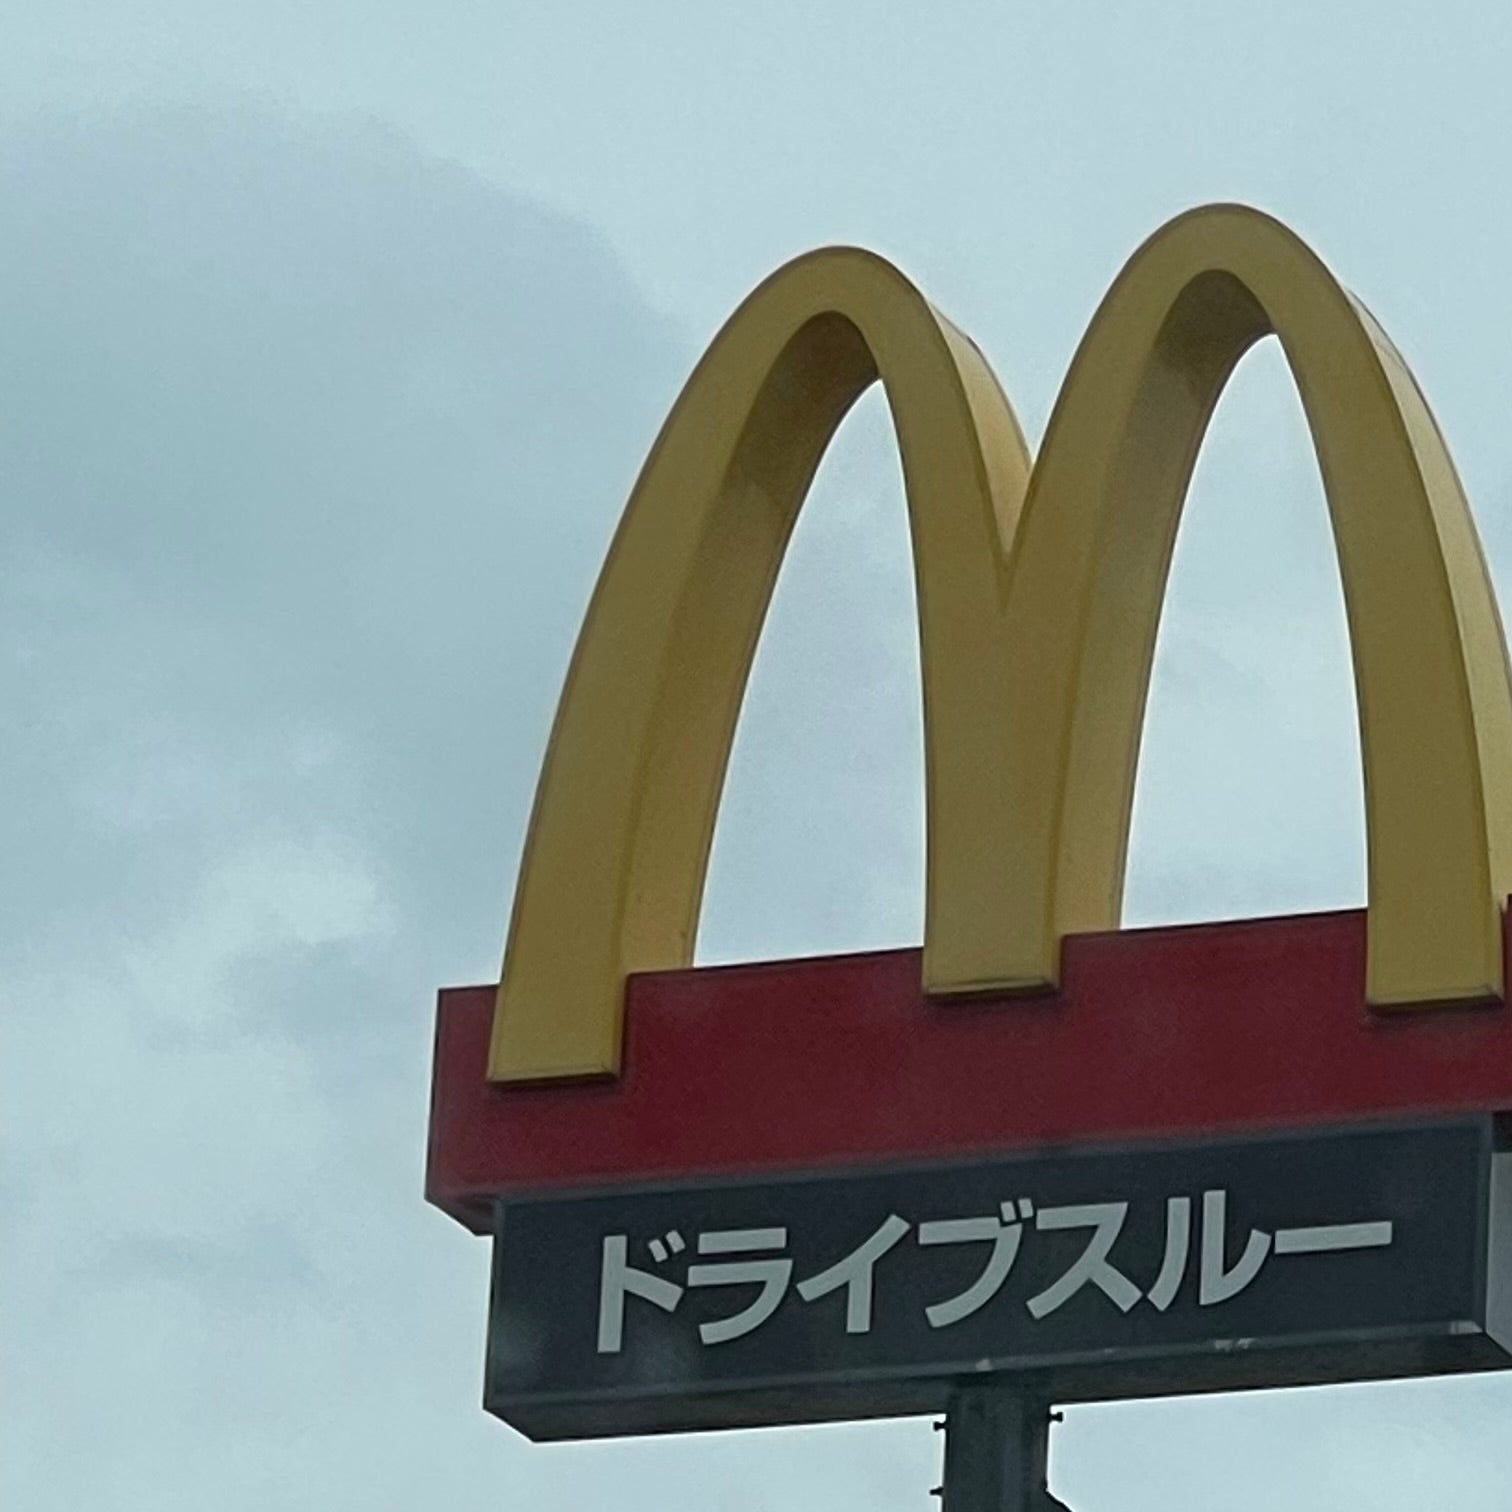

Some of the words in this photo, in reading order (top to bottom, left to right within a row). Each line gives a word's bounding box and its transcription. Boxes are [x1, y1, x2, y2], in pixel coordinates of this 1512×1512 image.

[598, 1189, 1393, 1353] ドライブスルー
